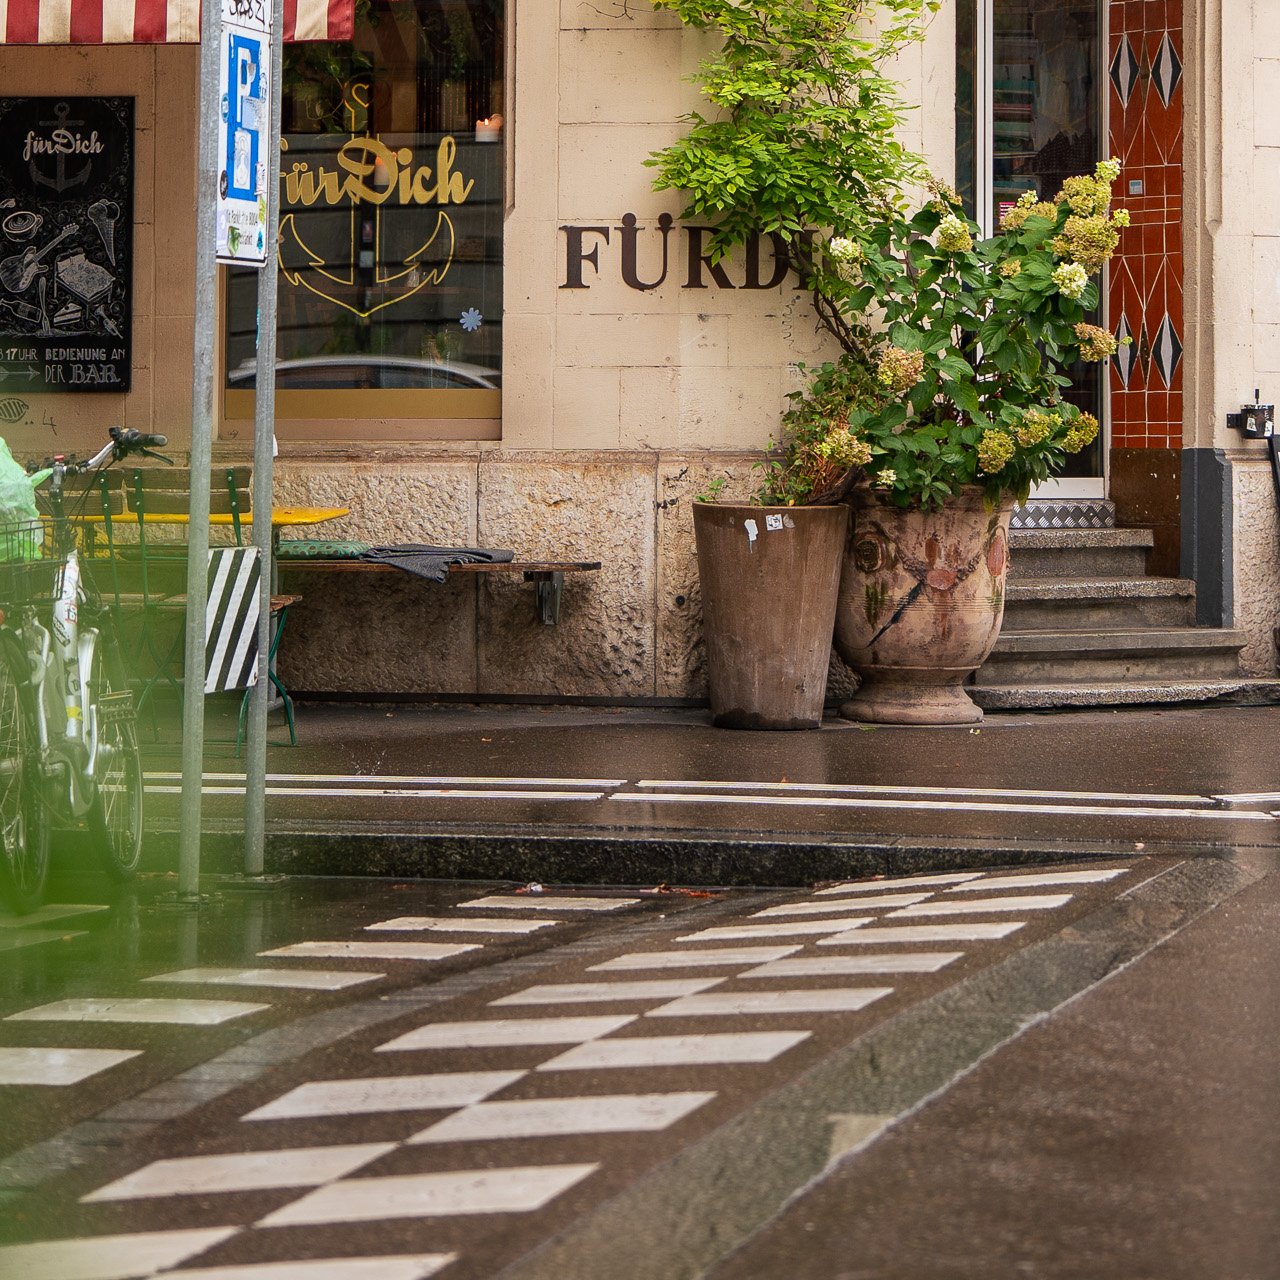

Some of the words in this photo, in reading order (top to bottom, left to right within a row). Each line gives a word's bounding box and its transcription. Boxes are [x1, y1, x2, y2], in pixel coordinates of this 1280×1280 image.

[558, 211, 842, 292] FÜRDI
[5, 347, 18, 361] 17
[18, 348, 38, 361] UHR
[45, 347, 107, 361] BEDIENUNG
[45, 364, 66, 383] DER
[68, 363, 122, 384] BAR
